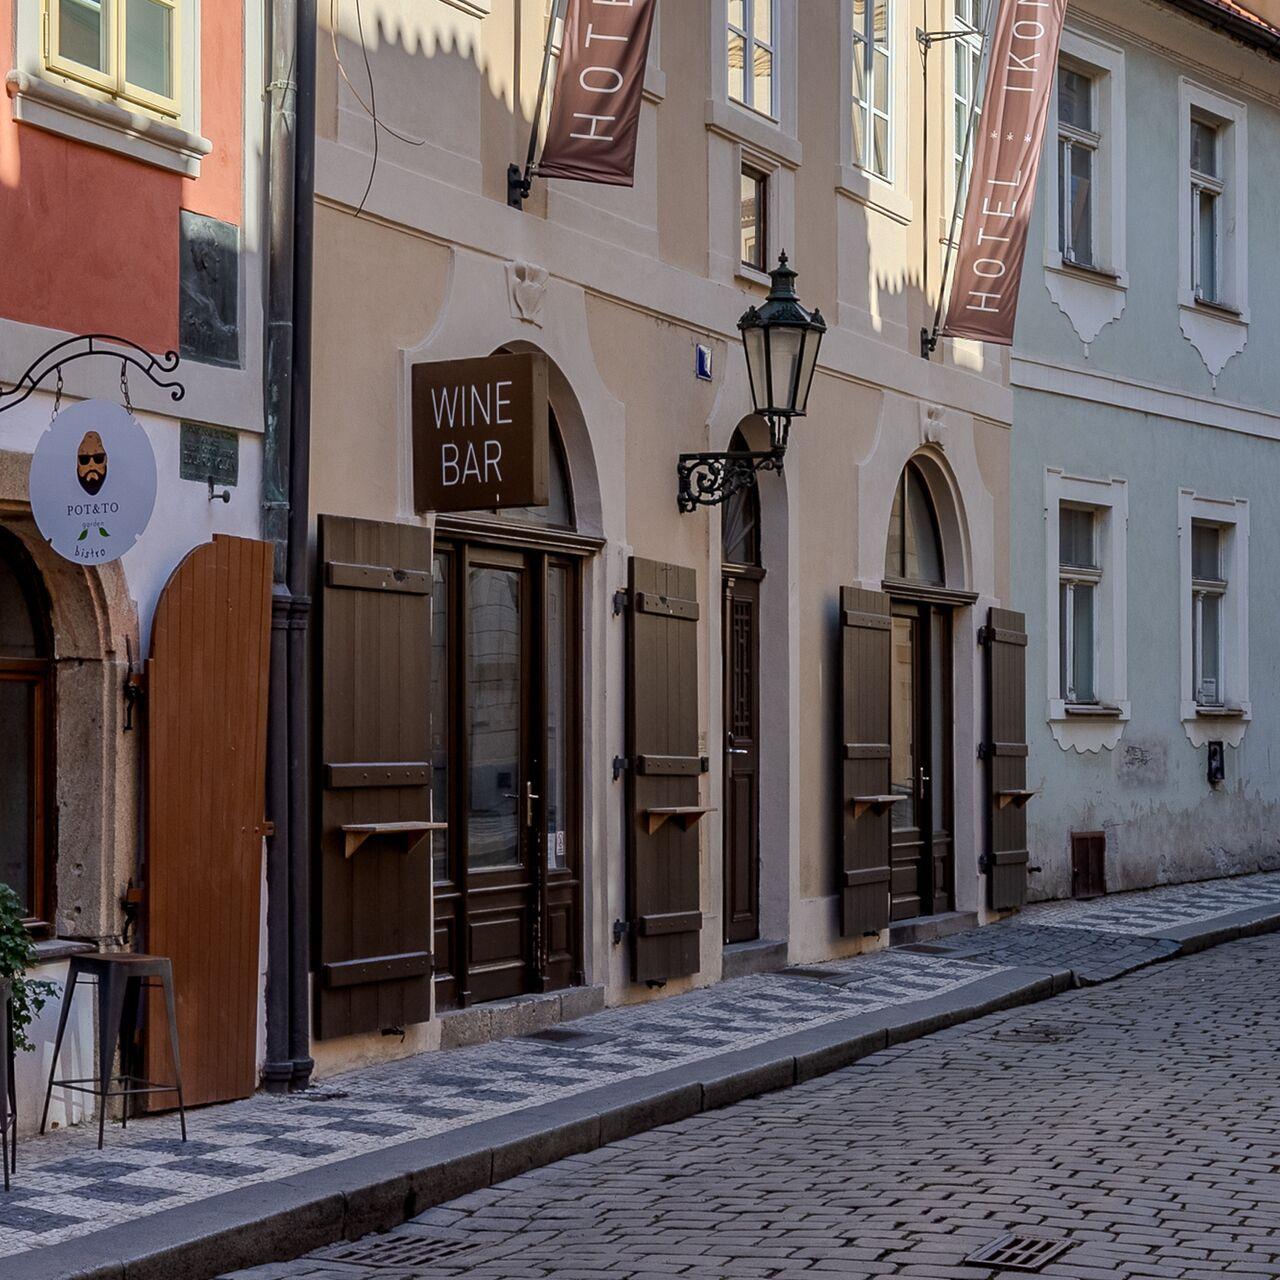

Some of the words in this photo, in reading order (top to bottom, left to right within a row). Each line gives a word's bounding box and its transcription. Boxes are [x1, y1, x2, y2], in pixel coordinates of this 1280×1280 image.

[966, 169, 1022, 313] HOTEL
[431, 381, 513, 430] WINE
[441, 440, 503, 486] BAR
[67, 502, 119, 516] POT&TO
[74, 544, 106, 558] bistro
